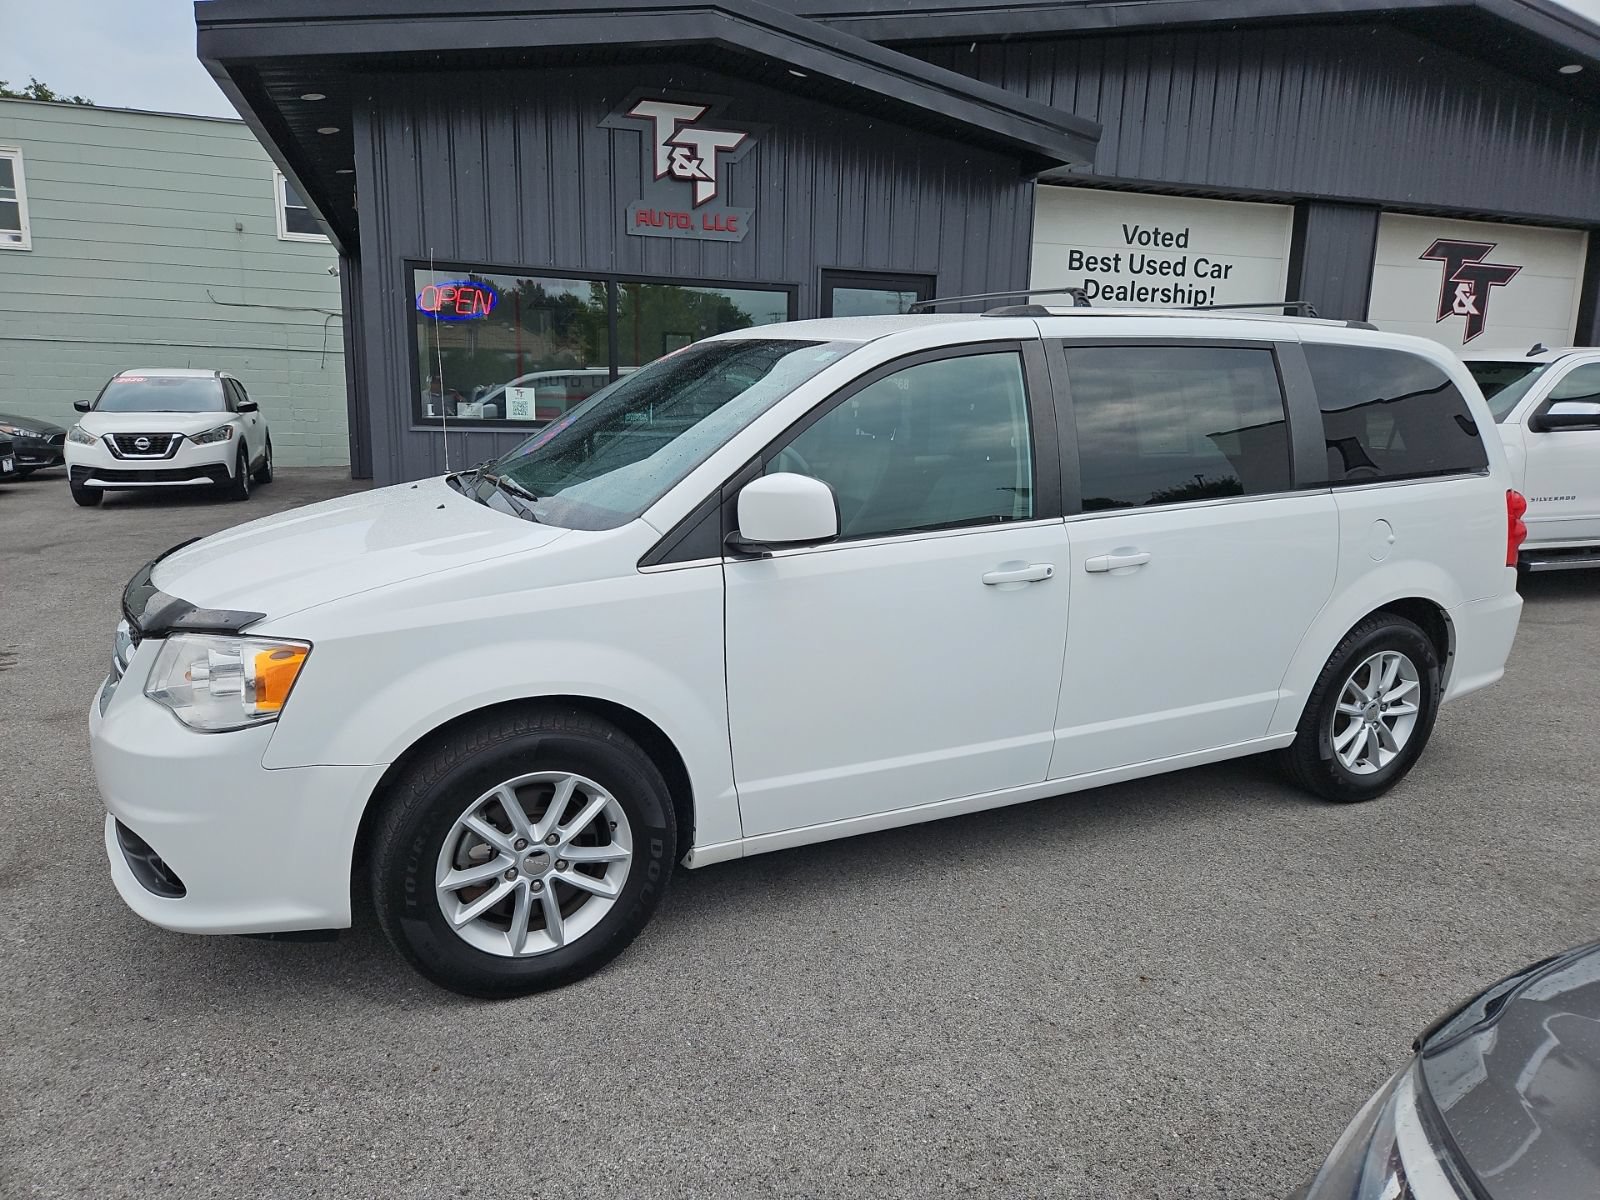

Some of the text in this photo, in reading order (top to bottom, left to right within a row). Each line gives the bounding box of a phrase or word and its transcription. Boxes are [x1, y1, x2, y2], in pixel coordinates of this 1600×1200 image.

[626, 98, 750, 207] T&T
[703, 212, 738, 233] LLC
[1122, 223, 1190, 249] Voted
[1068, 249, 1233, 279] Best Used Car
[420, 285, 493, 315] OPEN
[1083, 278, 1216, 307] Dealership!
[1418, 238, 1523, 345] T&T
[1530, 495, 1577, 503] SILVERADO
